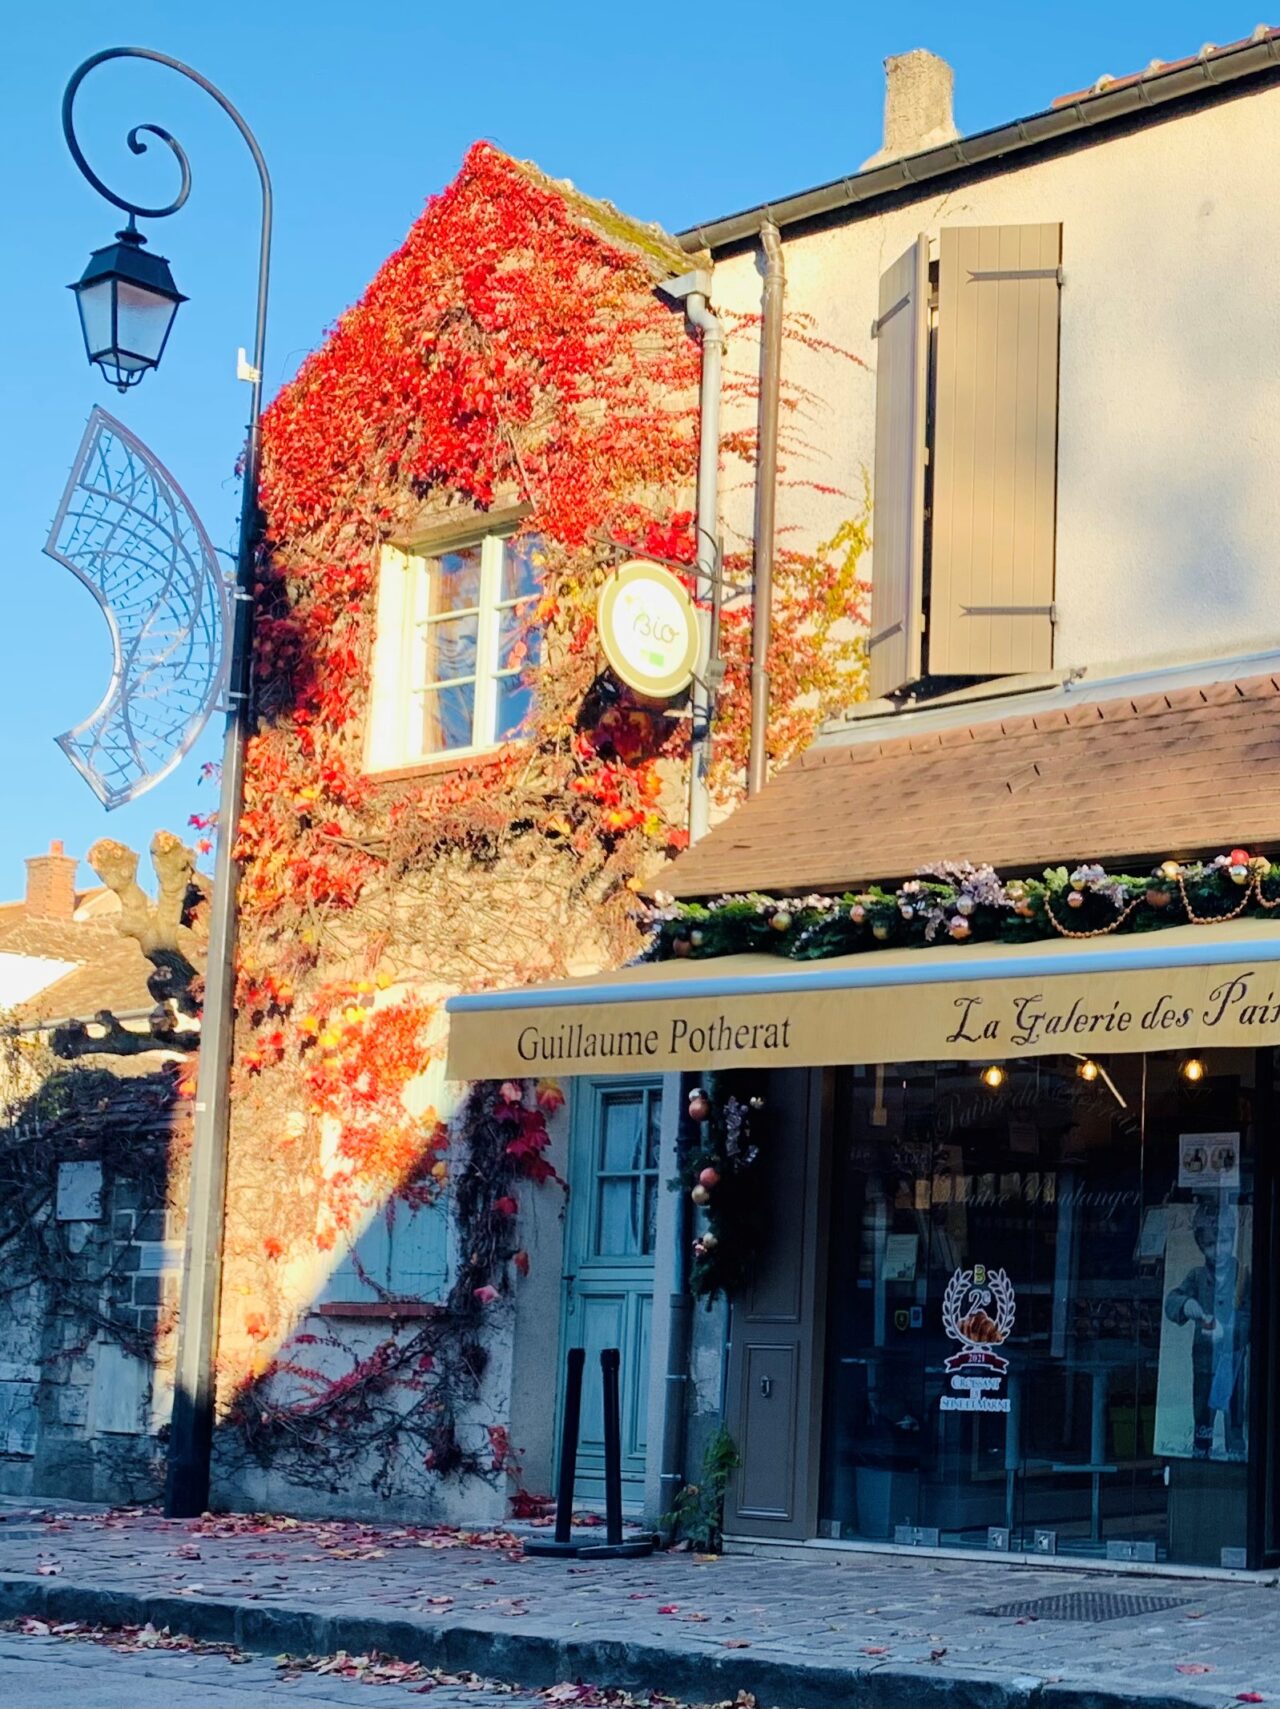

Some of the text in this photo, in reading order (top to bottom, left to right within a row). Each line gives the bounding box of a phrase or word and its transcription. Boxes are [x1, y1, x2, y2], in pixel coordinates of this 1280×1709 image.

[517, 1016, 790, 1062] Guillaume Potherat
[946, 997, 1000, 1043] La
[1009, 994, 1132, 1046] Galerie
[1141, 994, 1193, 1029] des
[968, 1353, 985, 1363] 2021
